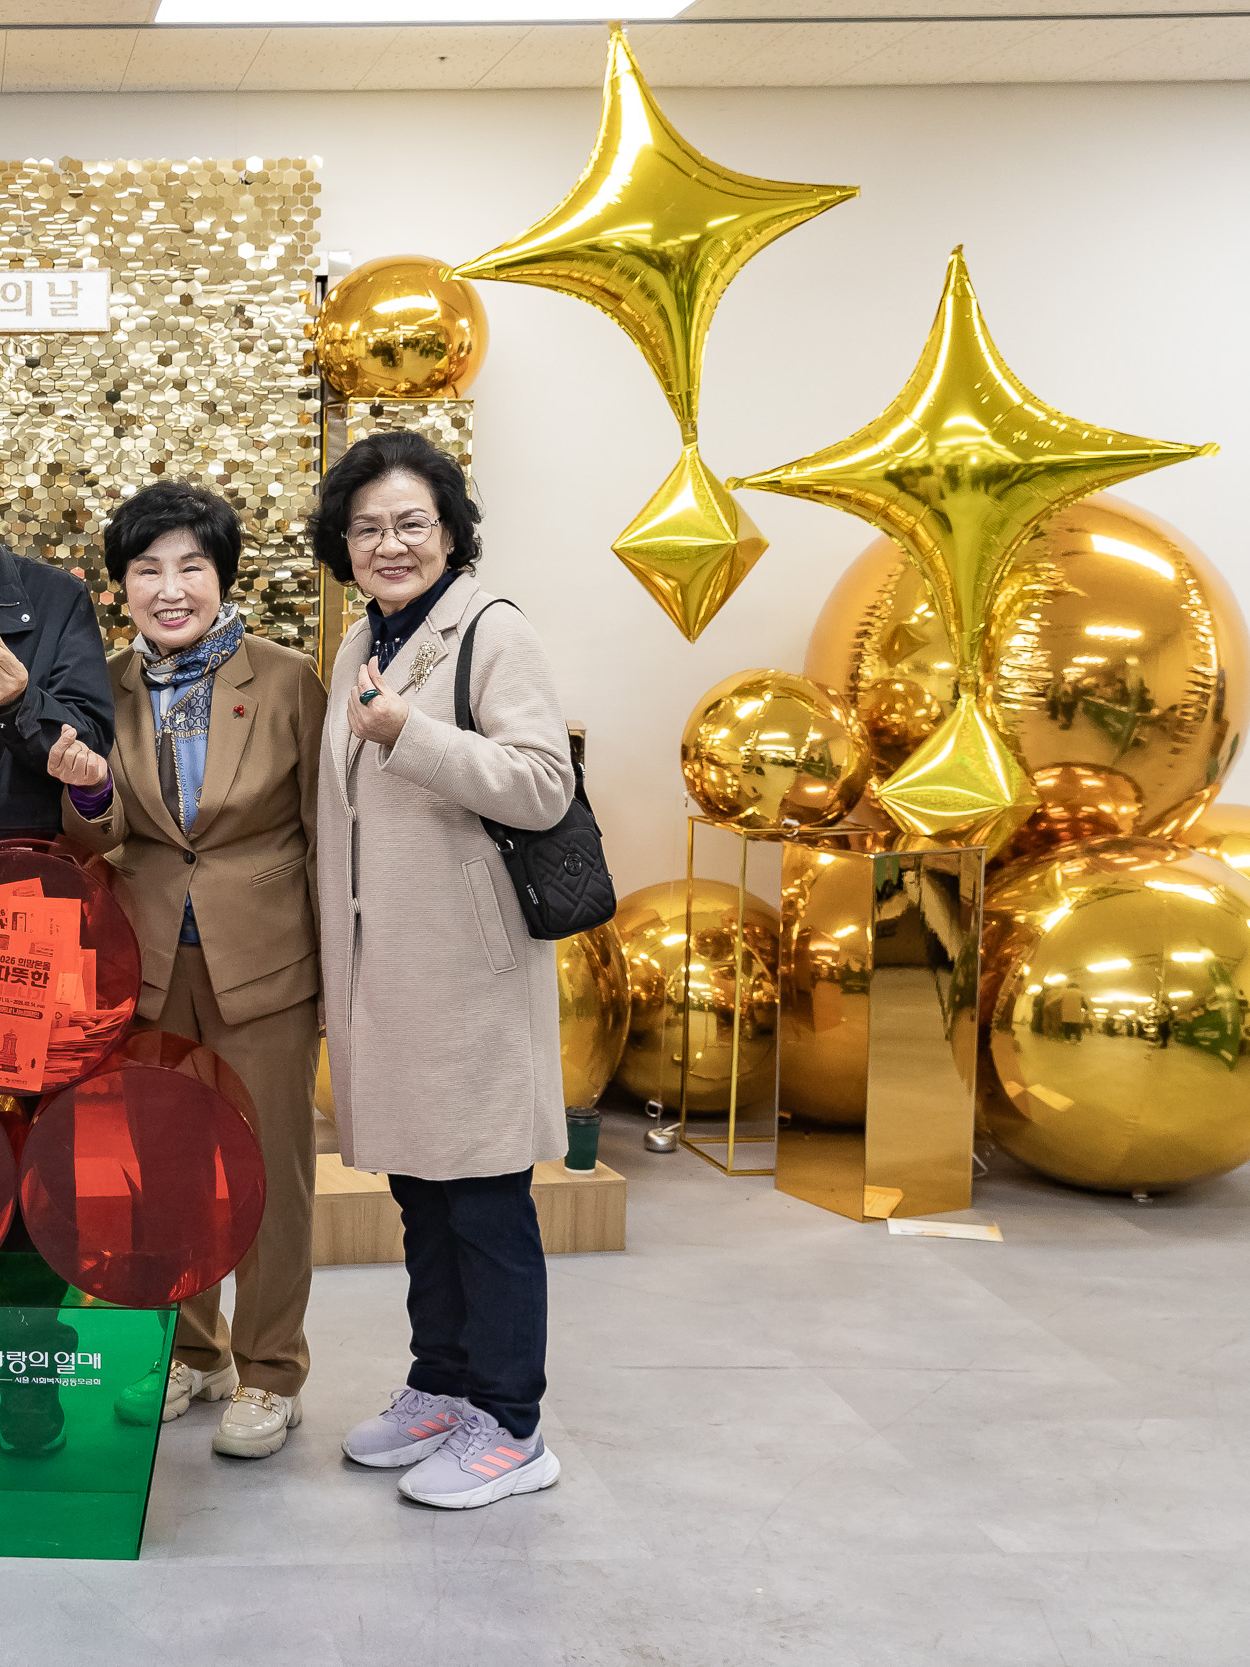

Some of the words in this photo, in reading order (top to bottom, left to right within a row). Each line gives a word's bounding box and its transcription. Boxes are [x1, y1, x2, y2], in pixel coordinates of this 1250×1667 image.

[46, 280, 83, 317] 날
[54, 1351, 102, 1375] 열매
[14, 1376, 30, 1384] 서울
[31, 1376, 101, 1387] 사회복지공동모금회
